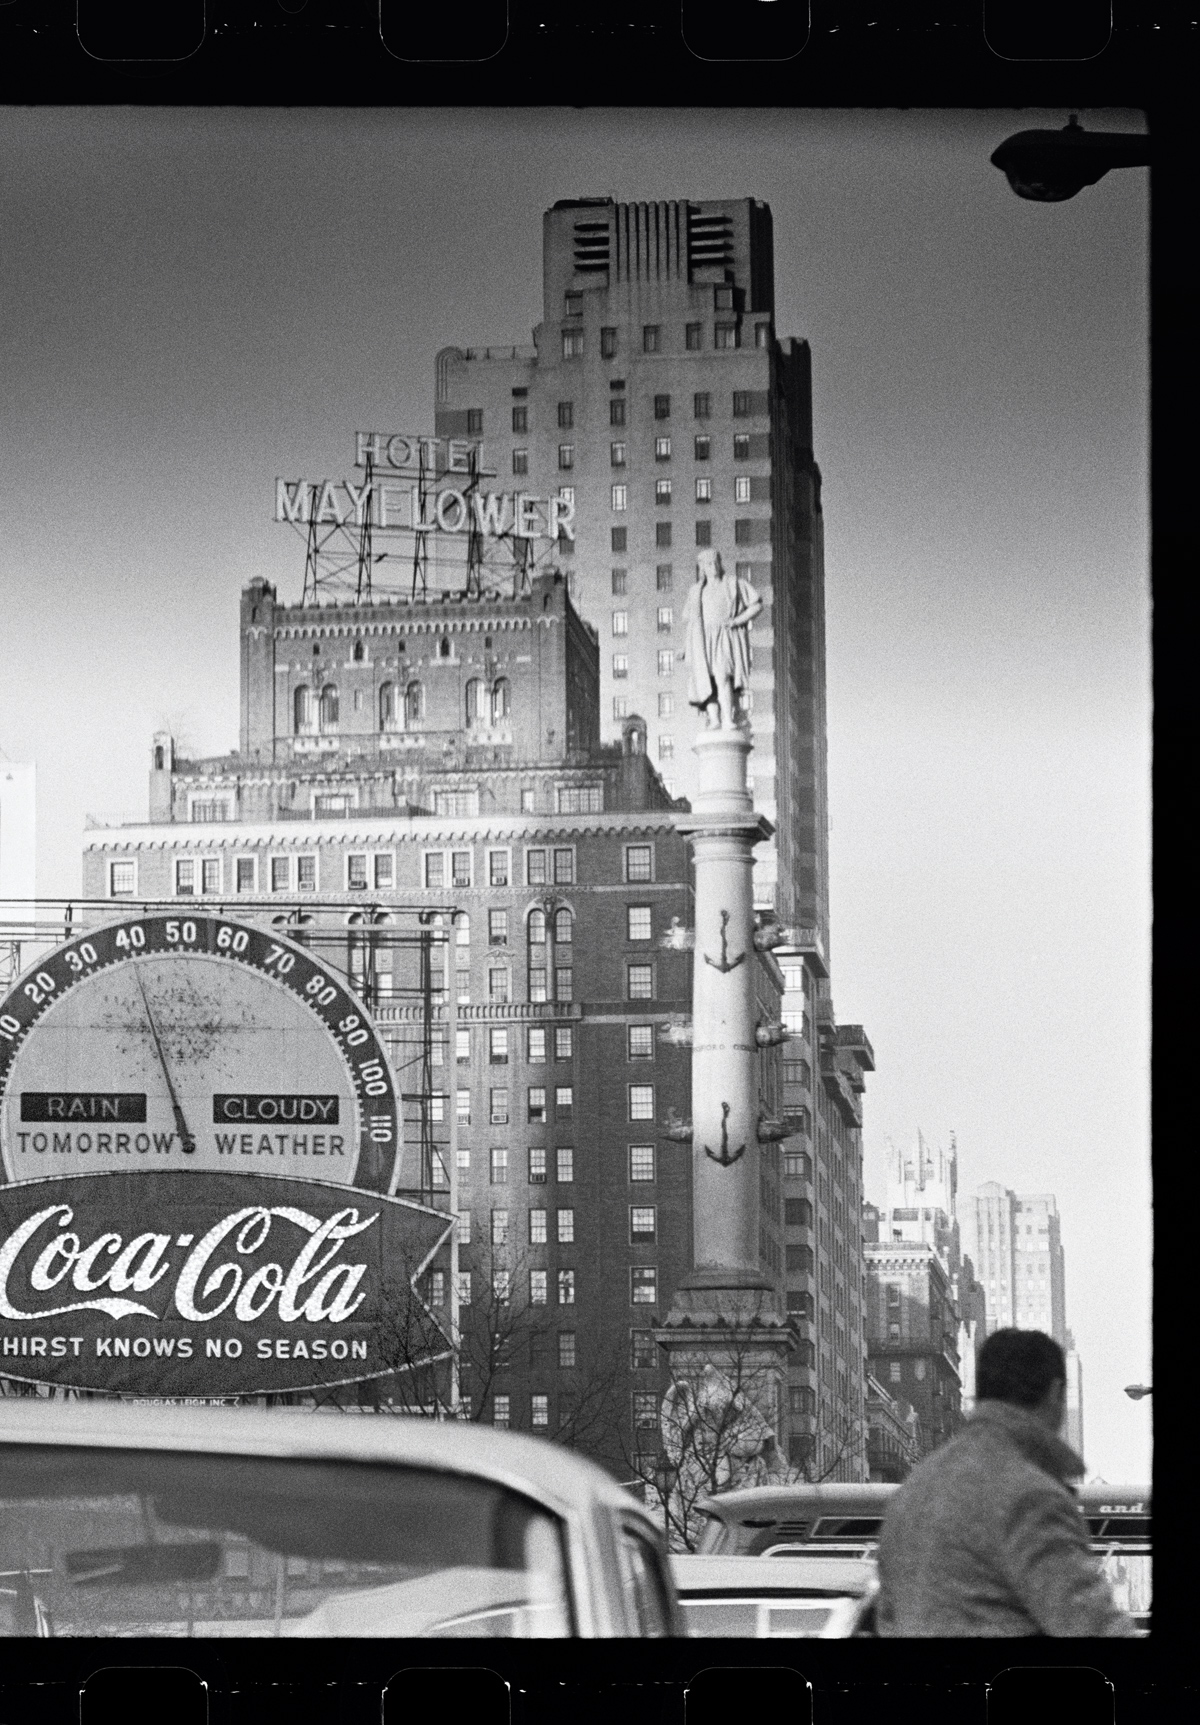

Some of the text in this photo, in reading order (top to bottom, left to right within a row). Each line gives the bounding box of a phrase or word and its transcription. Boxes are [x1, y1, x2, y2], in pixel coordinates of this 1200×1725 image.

[355, 432, 497, 476] HOTEL
[275, 477, 575, 540] MAYFLOWER
[115, 926, 146, 949] 40
[166, 921, 197, 943] 50
[217, 927, 249, 952] 60
[65, 943, 98, 972] 30
[264, 944, 296, 974] 70
[24, 972, 56, 1004] 20
[306, 975, 338, 1006] 80
[339, 1015, 369, 1046] 90
[358, 1058, 388, 1096] 100
[48, 1097, 120, 1117] RAIN
[223, 1098, 334, 1119] CLOUDY
[370, 1115, 393, 1143] 110
[214, 1133, 345, 1156] WEATHER
[97, 1337, 194, 1359] KNOWS
[206, 1338, 243, 1359] NO
[257, 1338, 368, 1360] SEASON
[132, 1399, 226, 1408] DOUGLAS LEIGH INC
[1099, 1502, 1144, 1514] and
